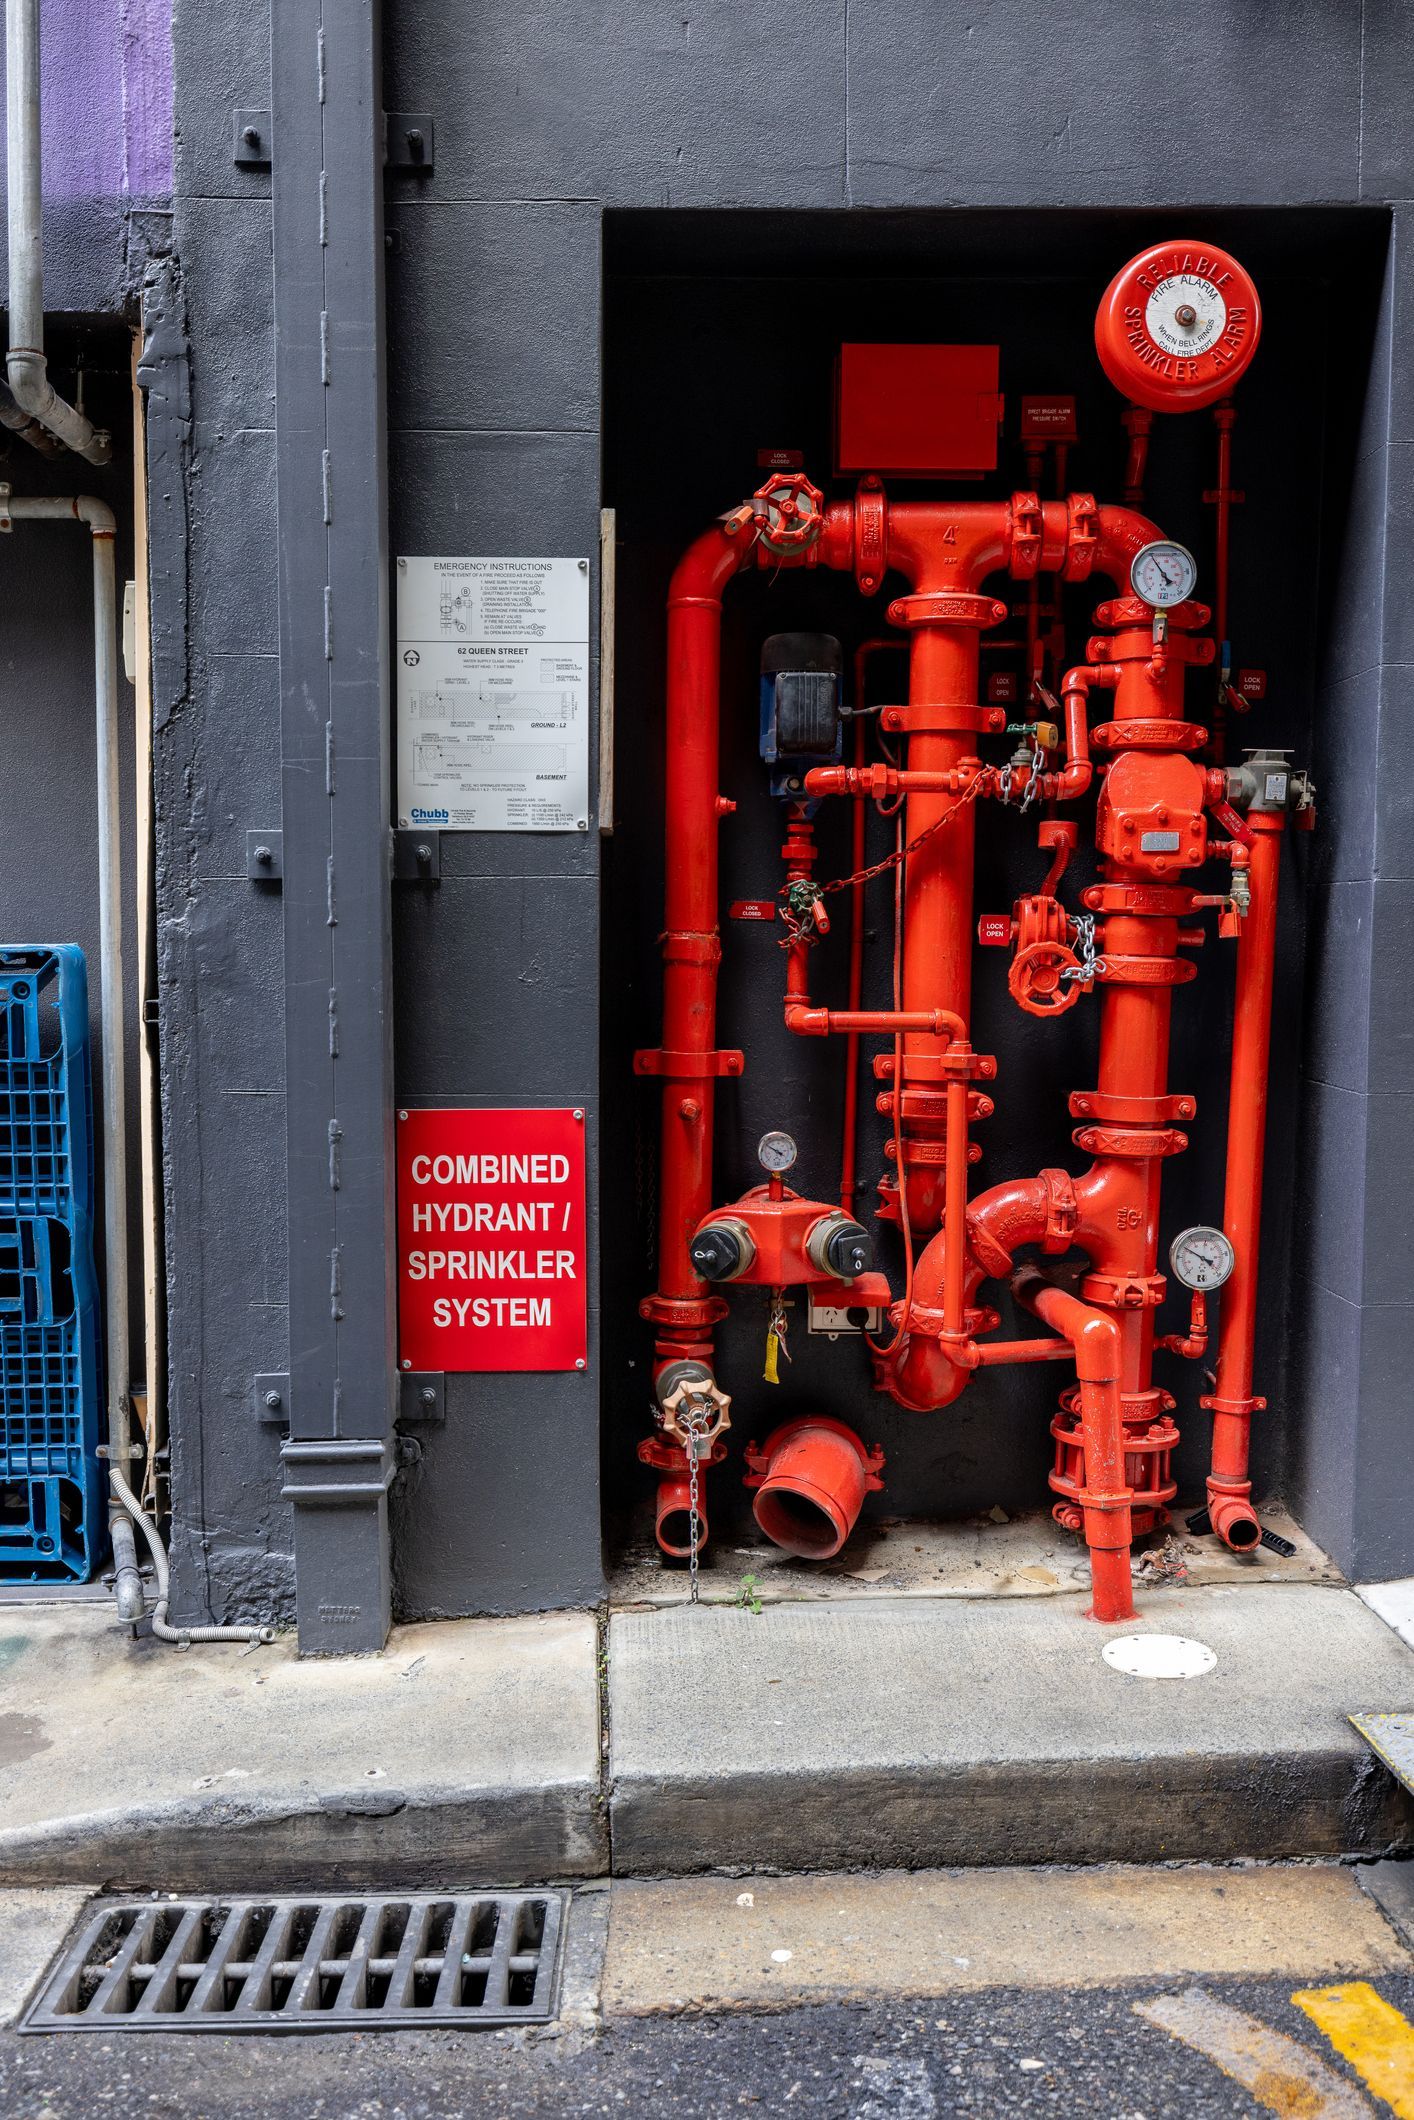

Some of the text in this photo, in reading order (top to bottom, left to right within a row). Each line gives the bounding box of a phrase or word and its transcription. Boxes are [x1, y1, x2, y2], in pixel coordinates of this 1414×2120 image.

[1137, 254, 1234, 288] RELIABLE
[1151, 275, 1219, 302] FIRE ALARM
[1124, 306, 1247, 378] SPRINKLER ALARM
[1158, 319, 1215, 347] WHEN BELL RINGS
[1158, 341, 1175, 355] CALL
[1177, 349, 1194, 357] FIRE
[433, 563, 553, 571] EMERGENCY INSTRUCTIONS
[411, 808, 449, 818] Chubb
[411, 1154, 570, 1184] COMBINED
[412, 1202, 571, 1232] HYDRANT /
[408, 1250, 576, 1280] SPRINKLER
[433, 1298, 551, 1327] SYSTEM
